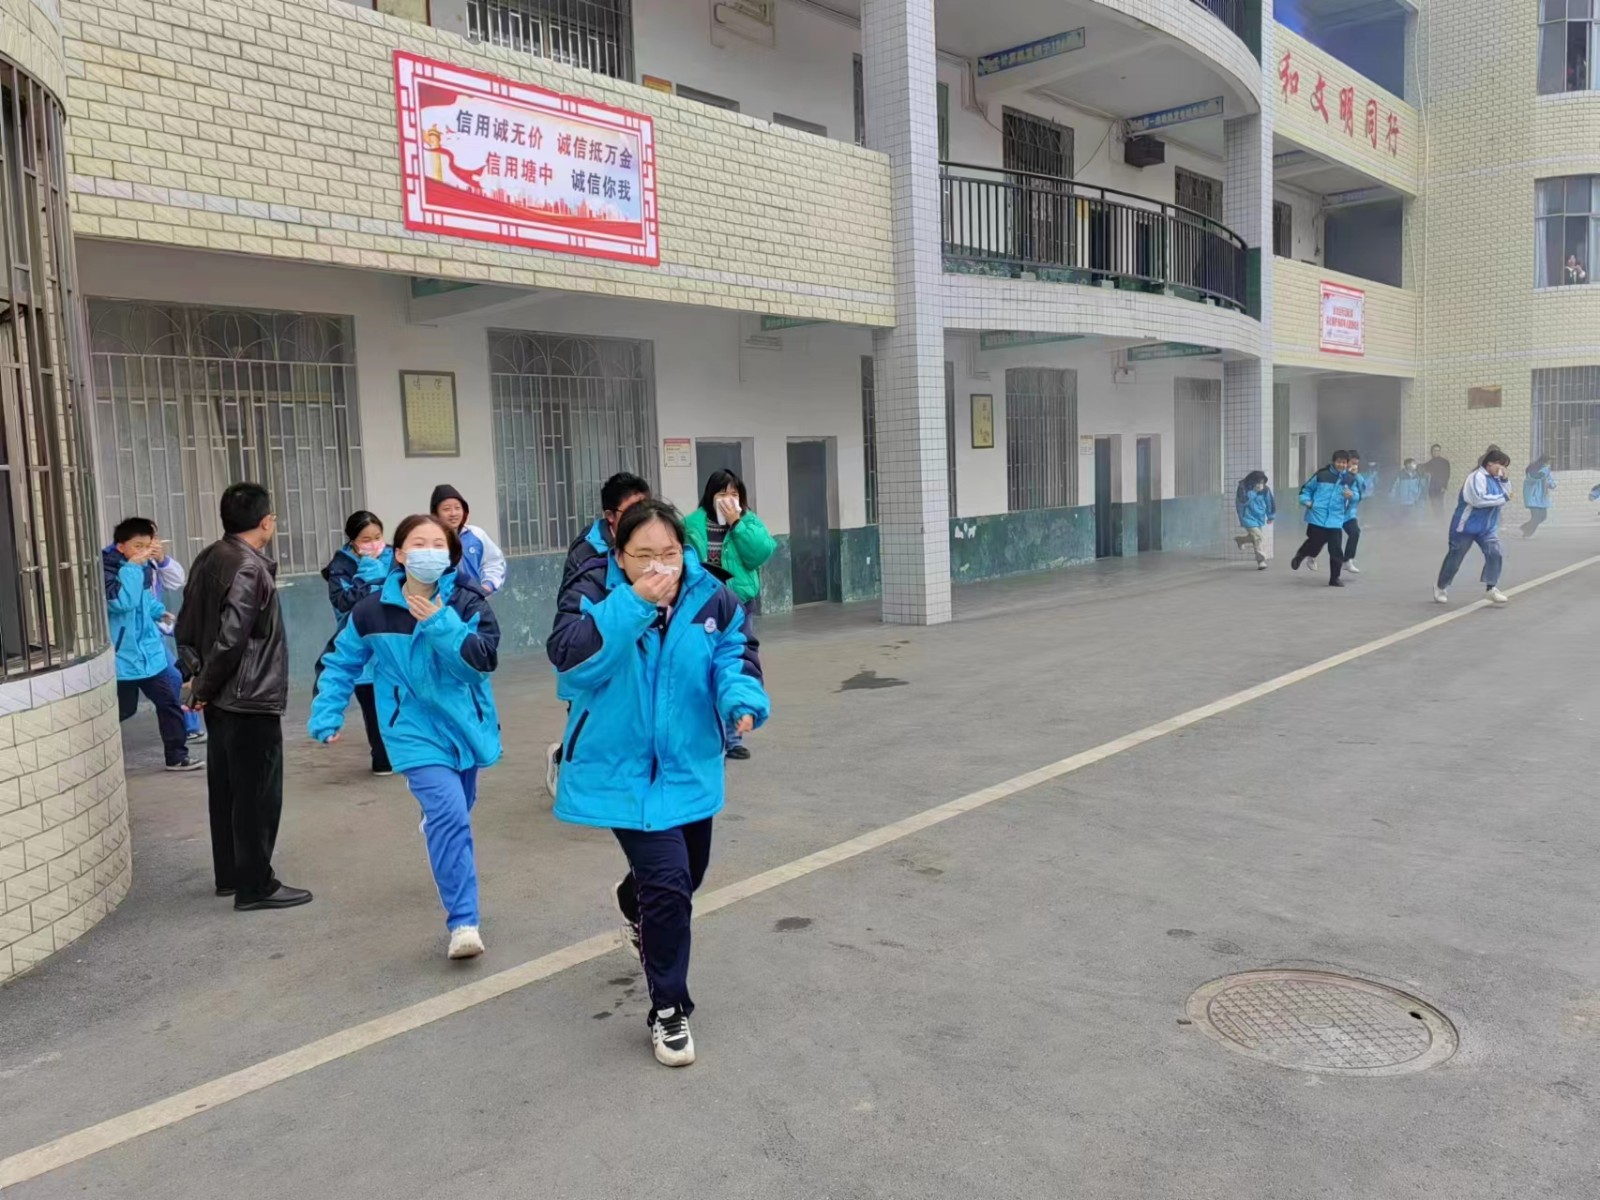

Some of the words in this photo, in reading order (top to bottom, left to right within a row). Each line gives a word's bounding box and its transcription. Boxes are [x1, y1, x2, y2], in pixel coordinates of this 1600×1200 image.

[1279, 51, 1400, 156] 和文明同行
[456, 109, 544, 150] 信用诚无价
[557, 133, 633, 169] 诚信抵万金
[485, 152, 554, 186] 信用塘中
[571, 170, 631, 201] 诚信你我
